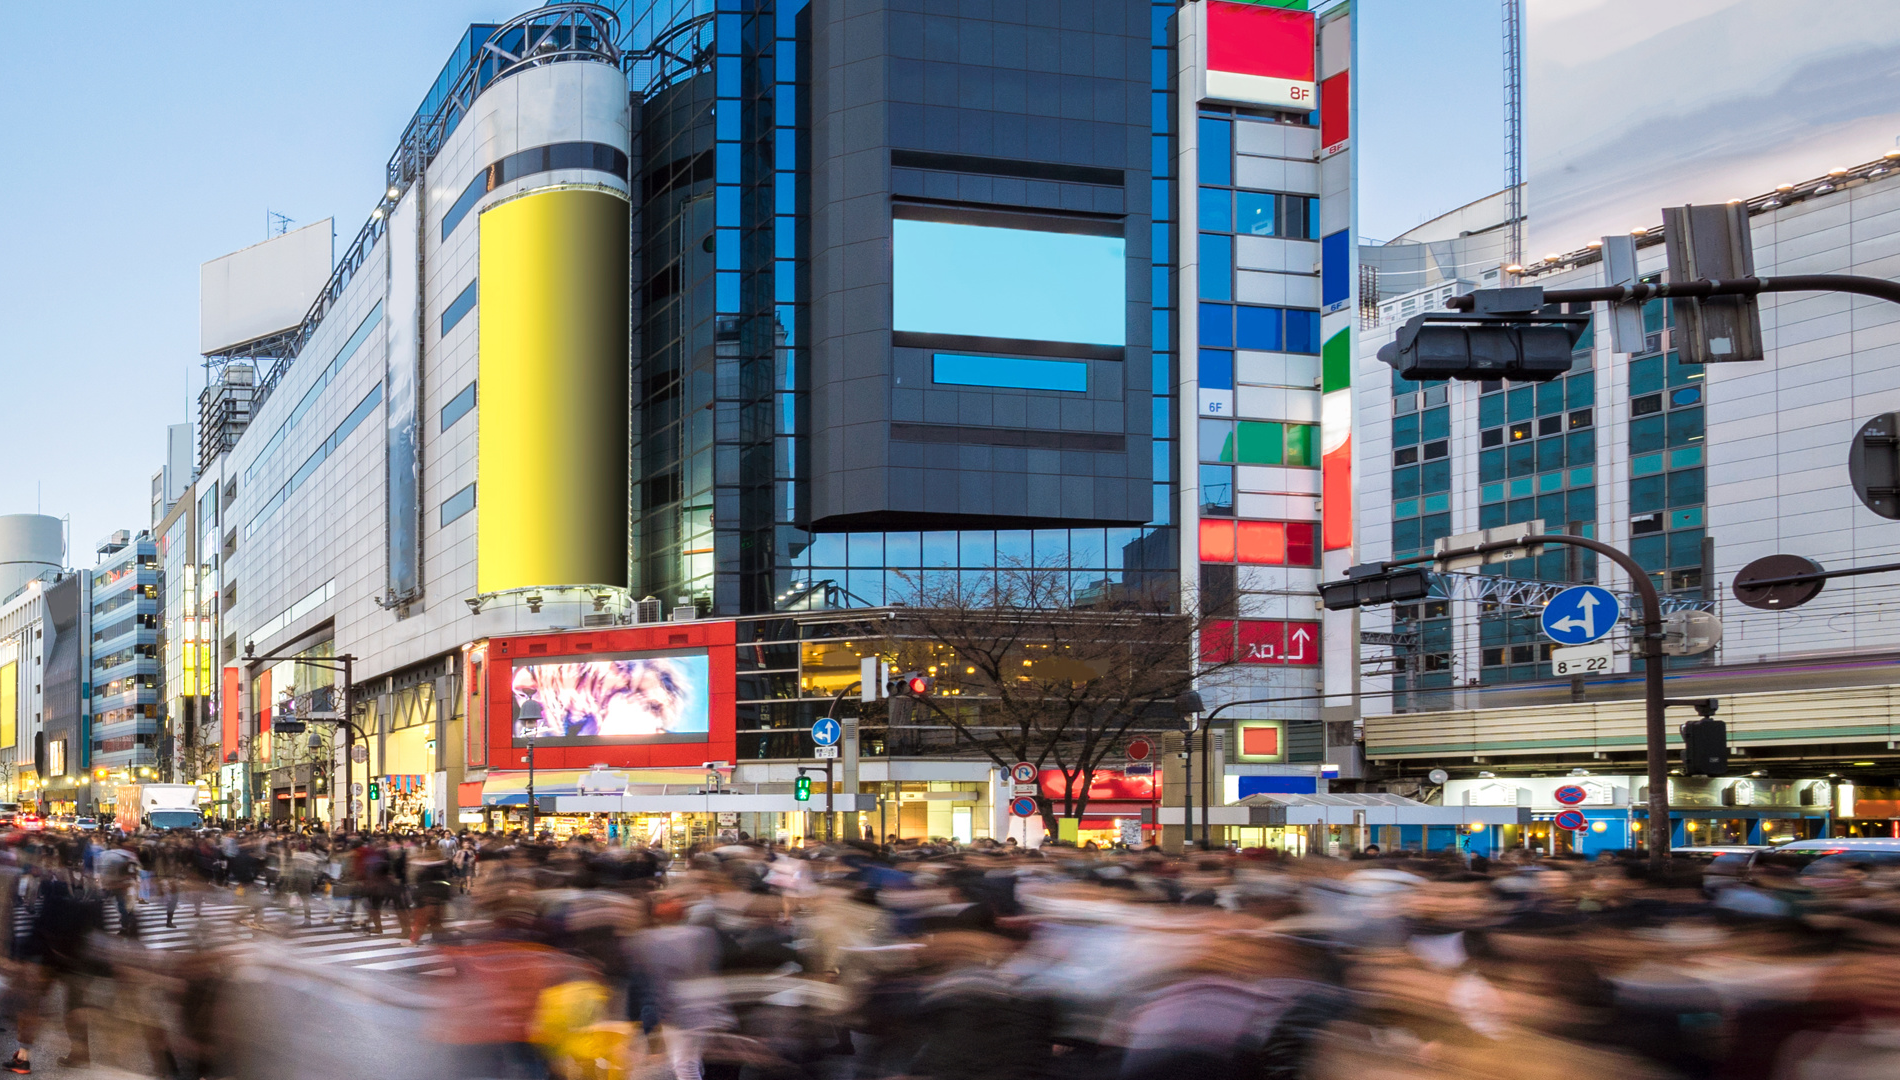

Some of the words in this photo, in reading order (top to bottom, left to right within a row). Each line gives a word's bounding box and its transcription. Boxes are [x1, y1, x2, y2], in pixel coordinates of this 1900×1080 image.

[1290, 86, 1309, 100] 8F
[1328, 143, 1343, 154] 8F
[1331, 301, 1343, 312] 6F
[1209, 402, 1222, 413] 6F
[1248, 643, 1274, 658] 入口
